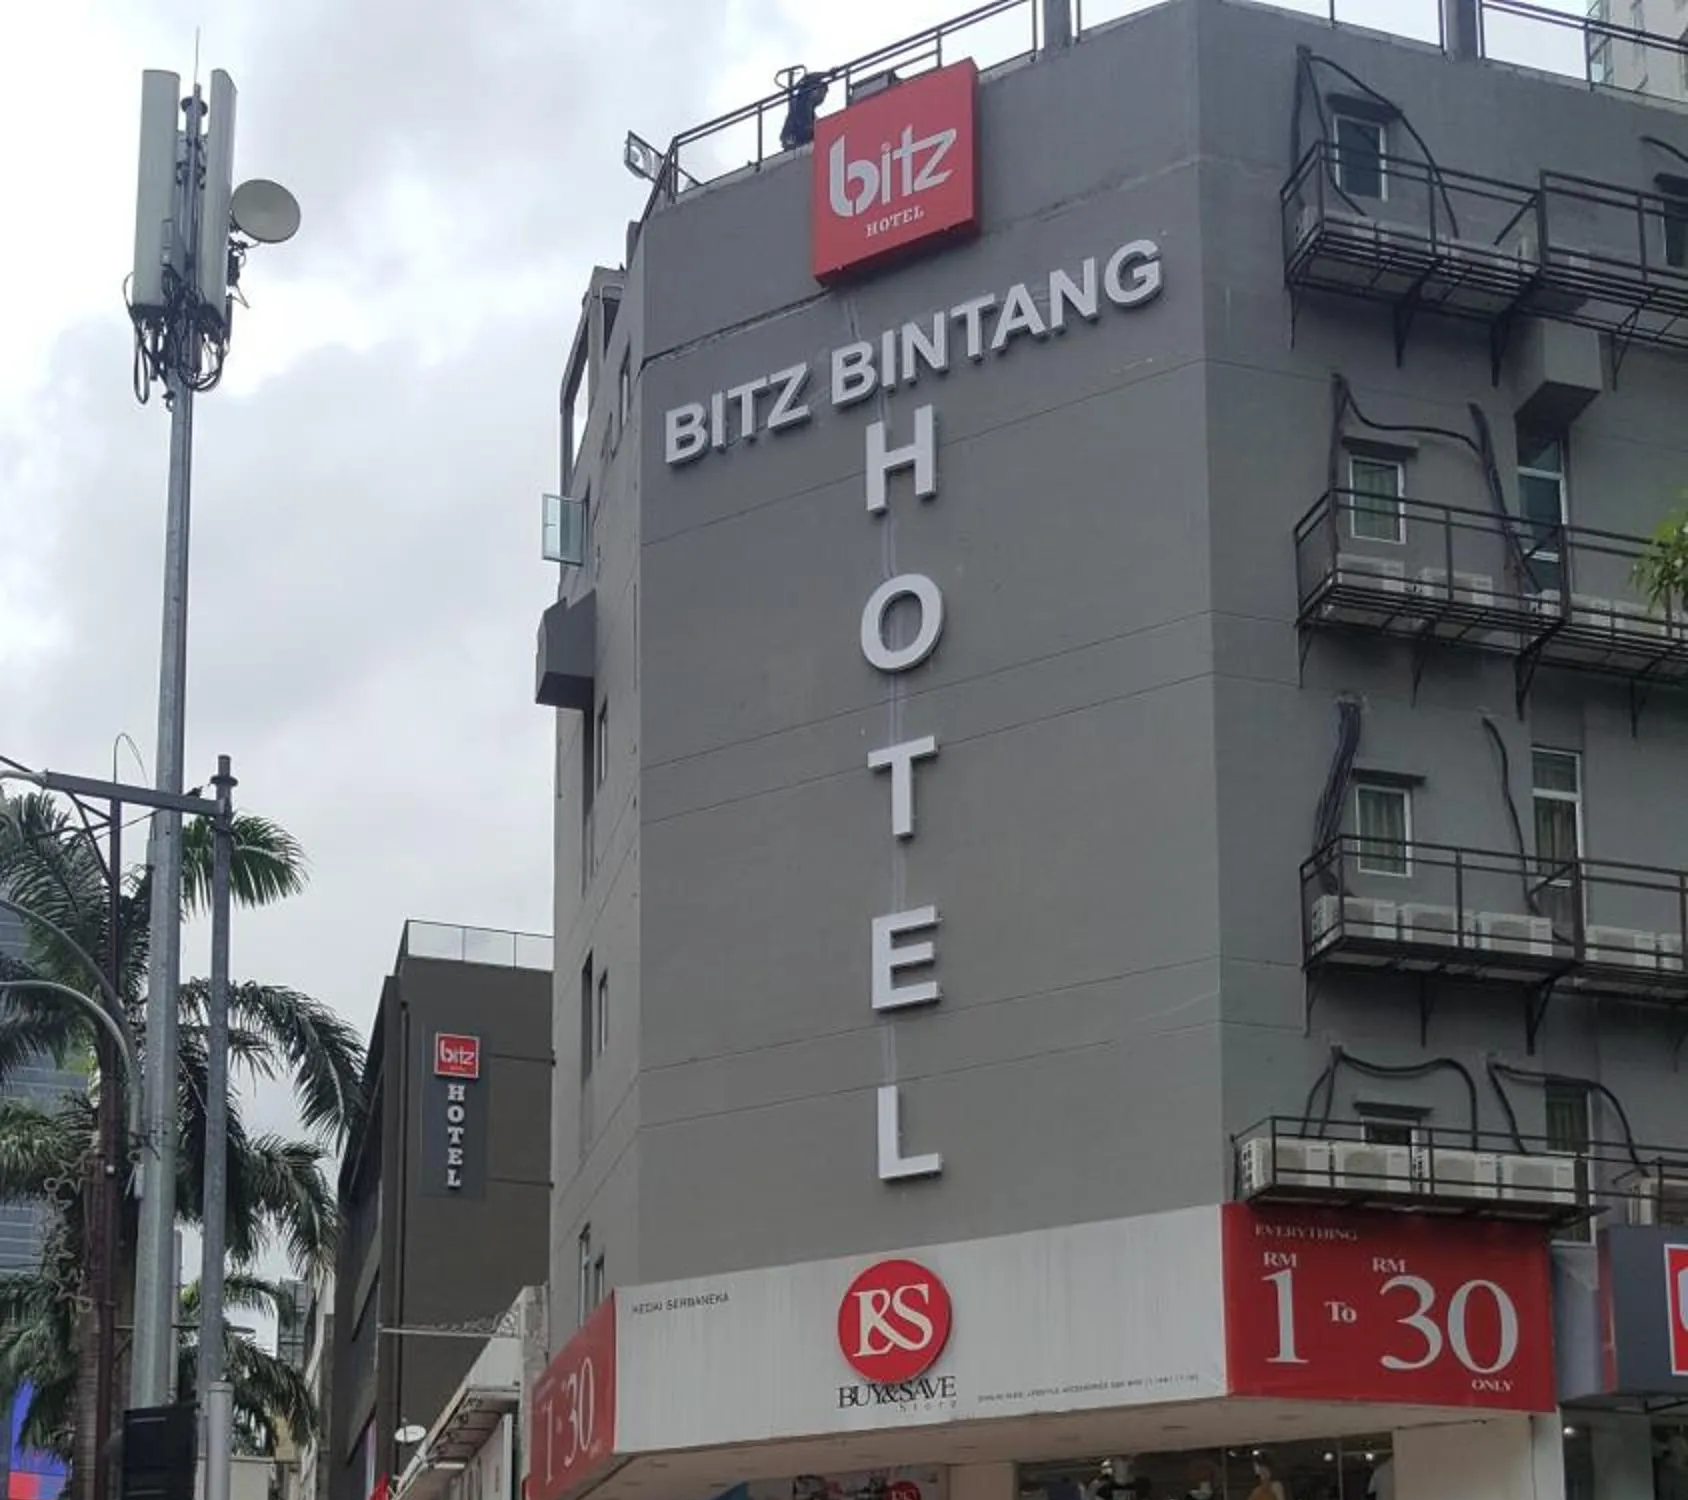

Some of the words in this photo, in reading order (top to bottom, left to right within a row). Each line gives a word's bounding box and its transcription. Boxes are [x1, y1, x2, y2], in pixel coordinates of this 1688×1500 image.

[828, 124, 957, 218] bitz
[865, 205, 926, 238] HOTEL
[665, 363, 811, 465] BITZ
[831, 239, 1162, 406] BINTANG
[861, 403, 945, 1182] HOTEL
[447, 1084, 465, 1187] HOTEL
[1255, 1223, 1358, 1241] EVERYTHING
[1264, 1251, 1297, 1268] RM
[1373, 1257, 1406, 1273] RM
[1262, 1268, 1309, 1364] 1
[1325, 1301, 1357, 1323] To
[1379, 1275, 1518, 1374] 30
[836, 1375, 957, 1408] BUY&SAVE
[1472, 1379, 1513, 1392] ONLY
